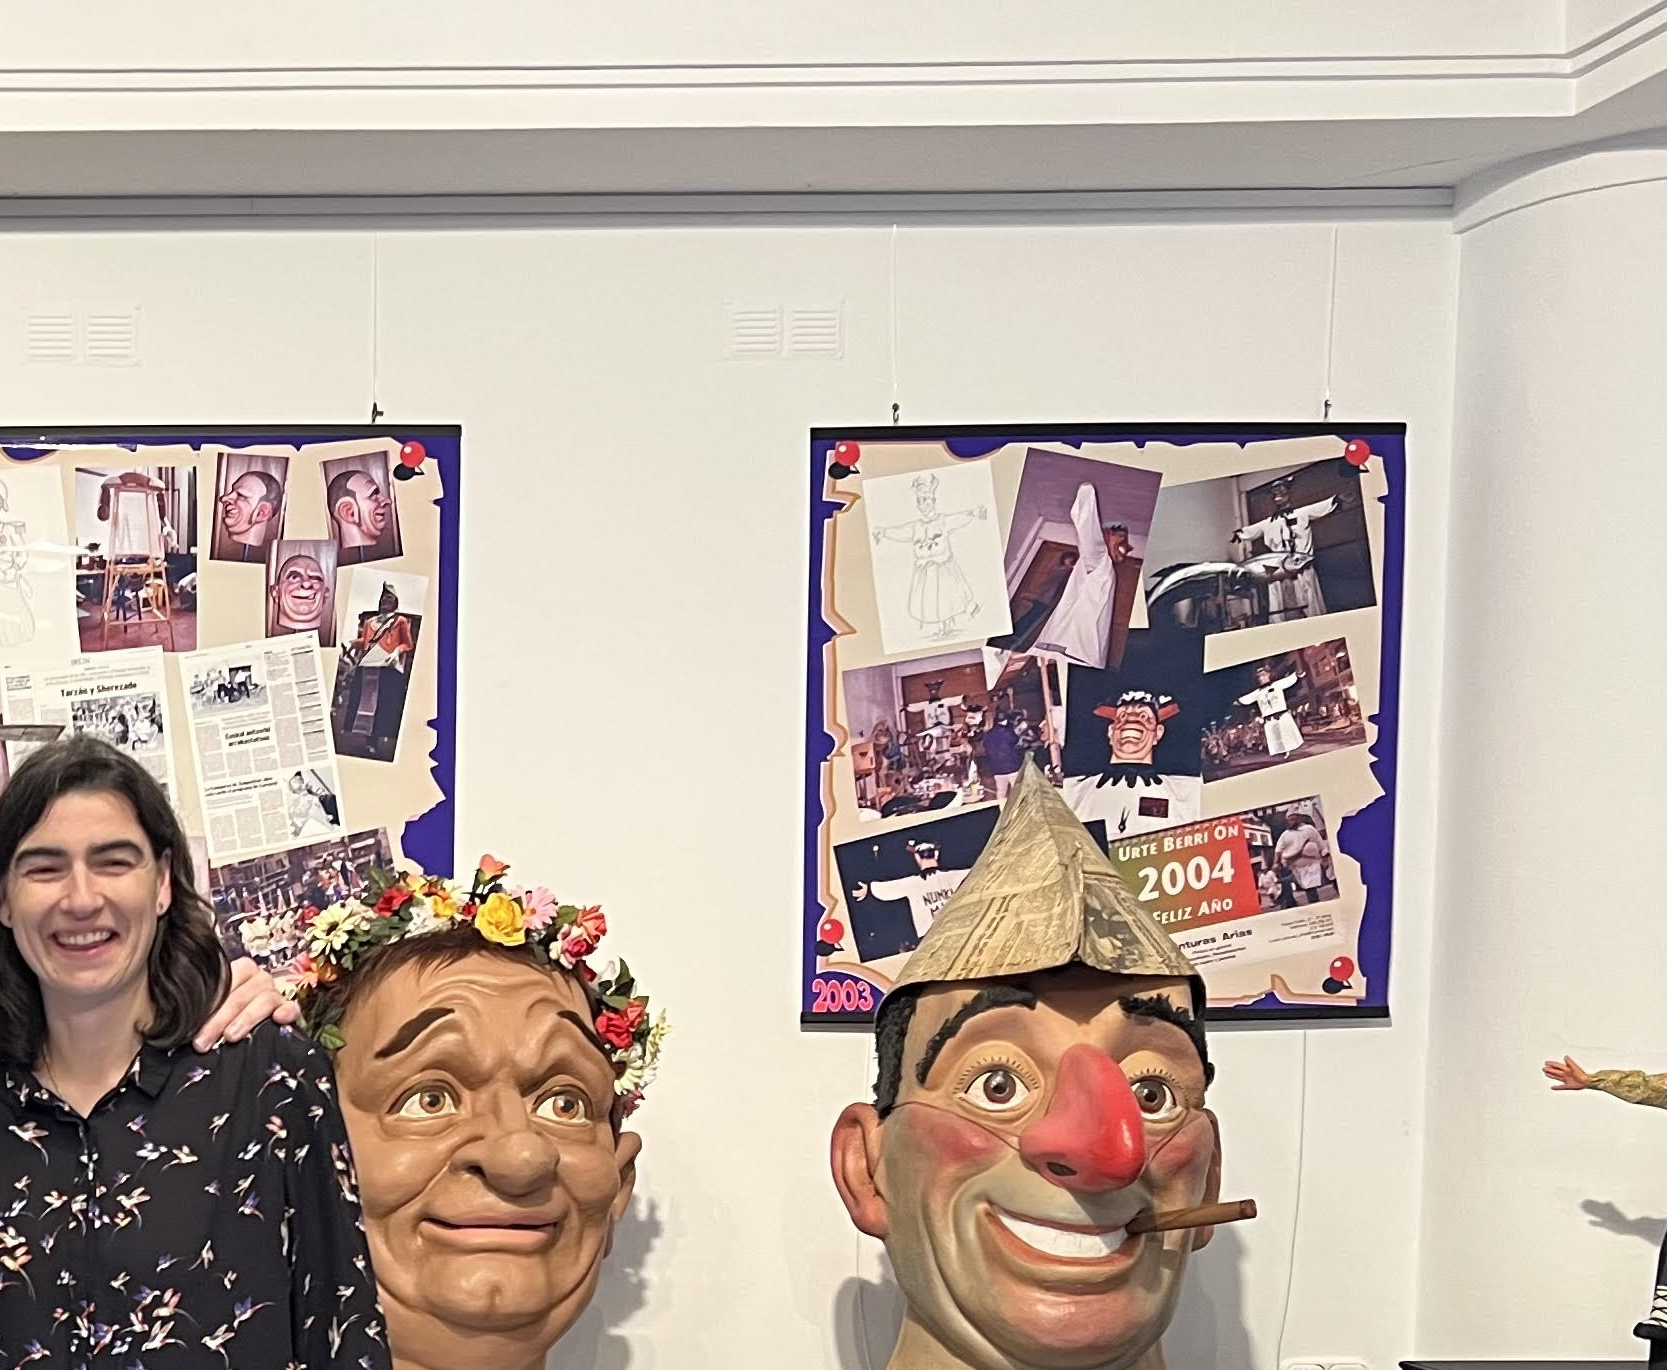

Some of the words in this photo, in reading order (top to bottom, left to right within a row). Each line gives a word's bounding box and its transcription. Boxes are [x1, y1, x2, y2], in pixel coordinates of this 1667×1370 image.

[1118, 842, 1158, 862] URTE
[1163, 831, 1209, 853] BERRI
[1213, 825, 1239, 840] ON
[1137, 849, 1235, 902] 2004
[1197, 898, 1233, 917] AÑO
[1178, 936, 1217, 950] nturas
[1222, 928, 1253, 941] Arias
[812, 978, 874, 1013] 2003
